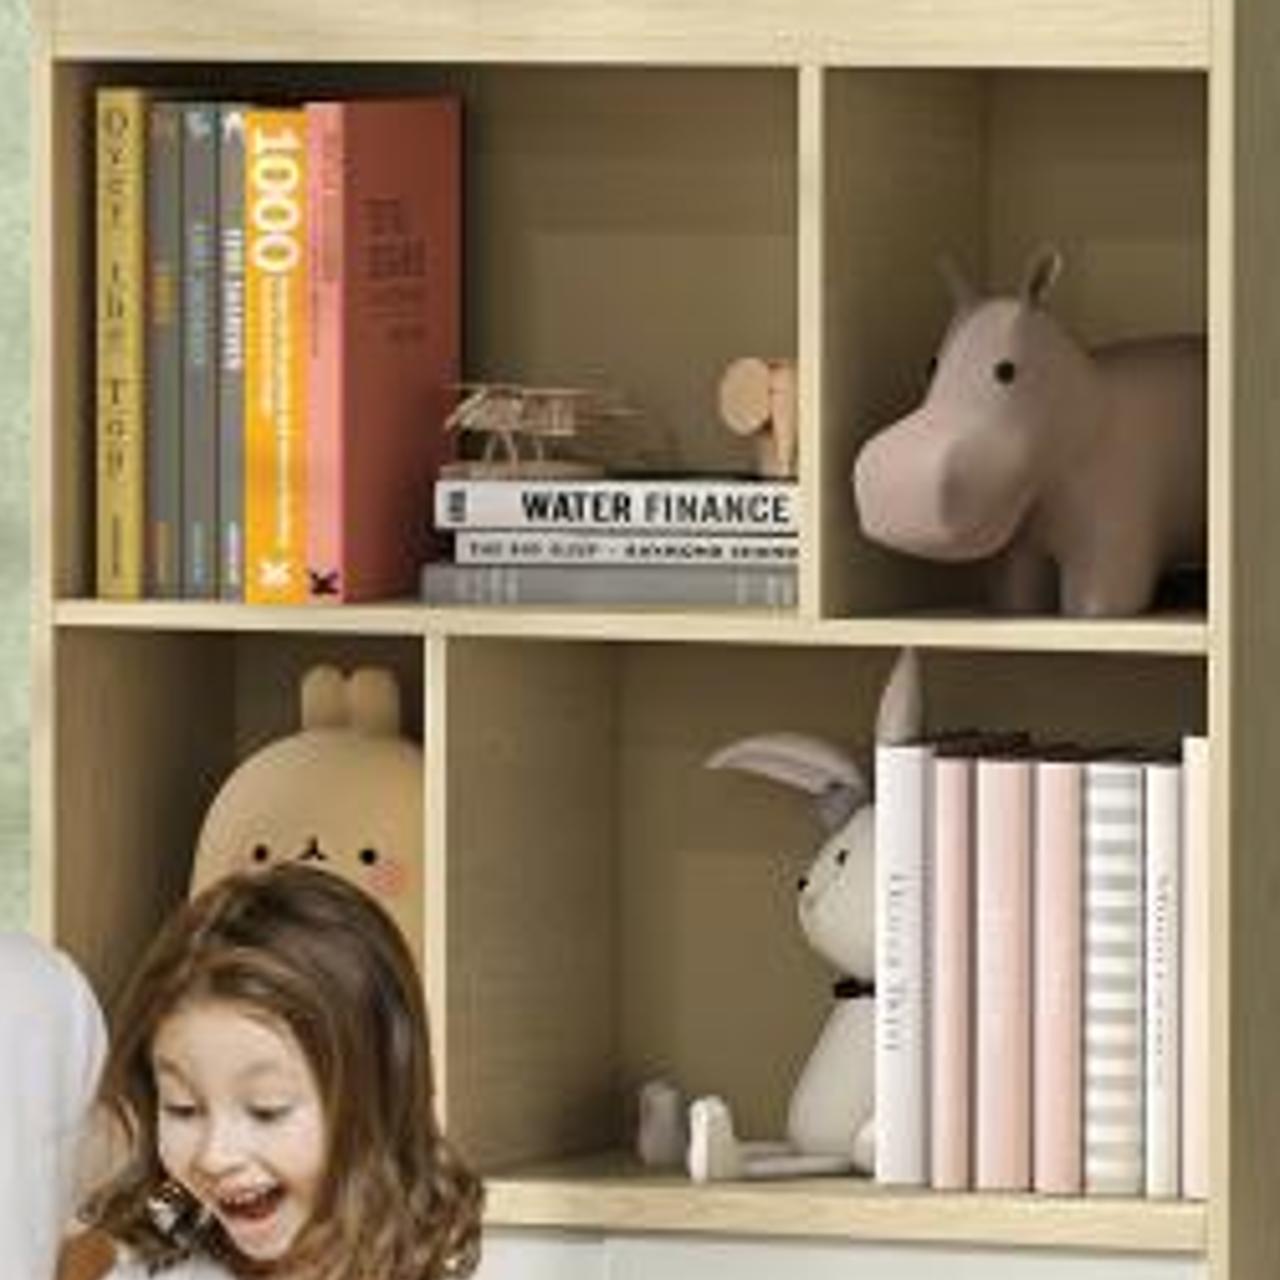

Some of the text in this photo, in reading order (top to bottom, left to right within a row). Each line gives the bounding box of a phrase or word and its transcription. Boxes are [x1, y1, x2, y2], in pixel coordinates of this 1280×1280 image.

[254, 126, 300, 273] 1000
[521, 490, 791, 524] WATER FINANCE
